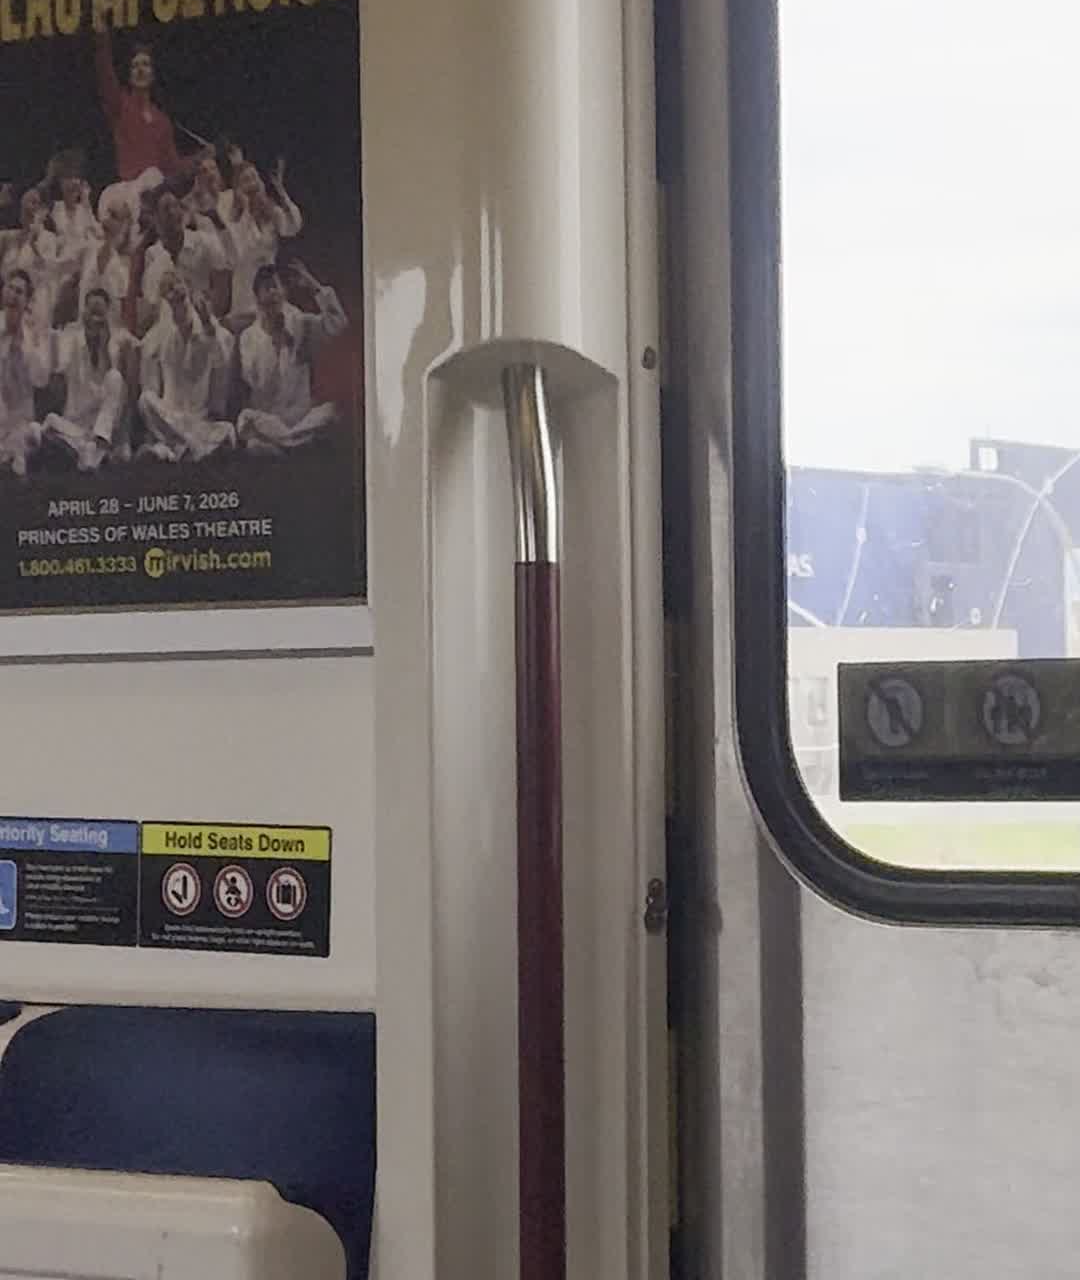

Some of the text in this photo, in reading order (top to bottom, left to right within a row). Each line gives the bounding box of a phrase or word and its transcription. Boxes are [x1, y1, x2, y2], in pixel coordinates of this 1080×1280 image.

[48, 500, 96, 518] APRIL
[99, 497, 119, 515] 28
[136, 494, 179, 513] JUNE
[183, 494, 195, 513] 7,
[199, 491, 240, 510] 2026
[18, 518, 272, 546] PRINCESS OF WALES THEATRE
[144, 546, 272, 578] mirvish.com
[50, 824, 109, 849] Seating
[165, 832, 305, 853] Hold Seats Down
